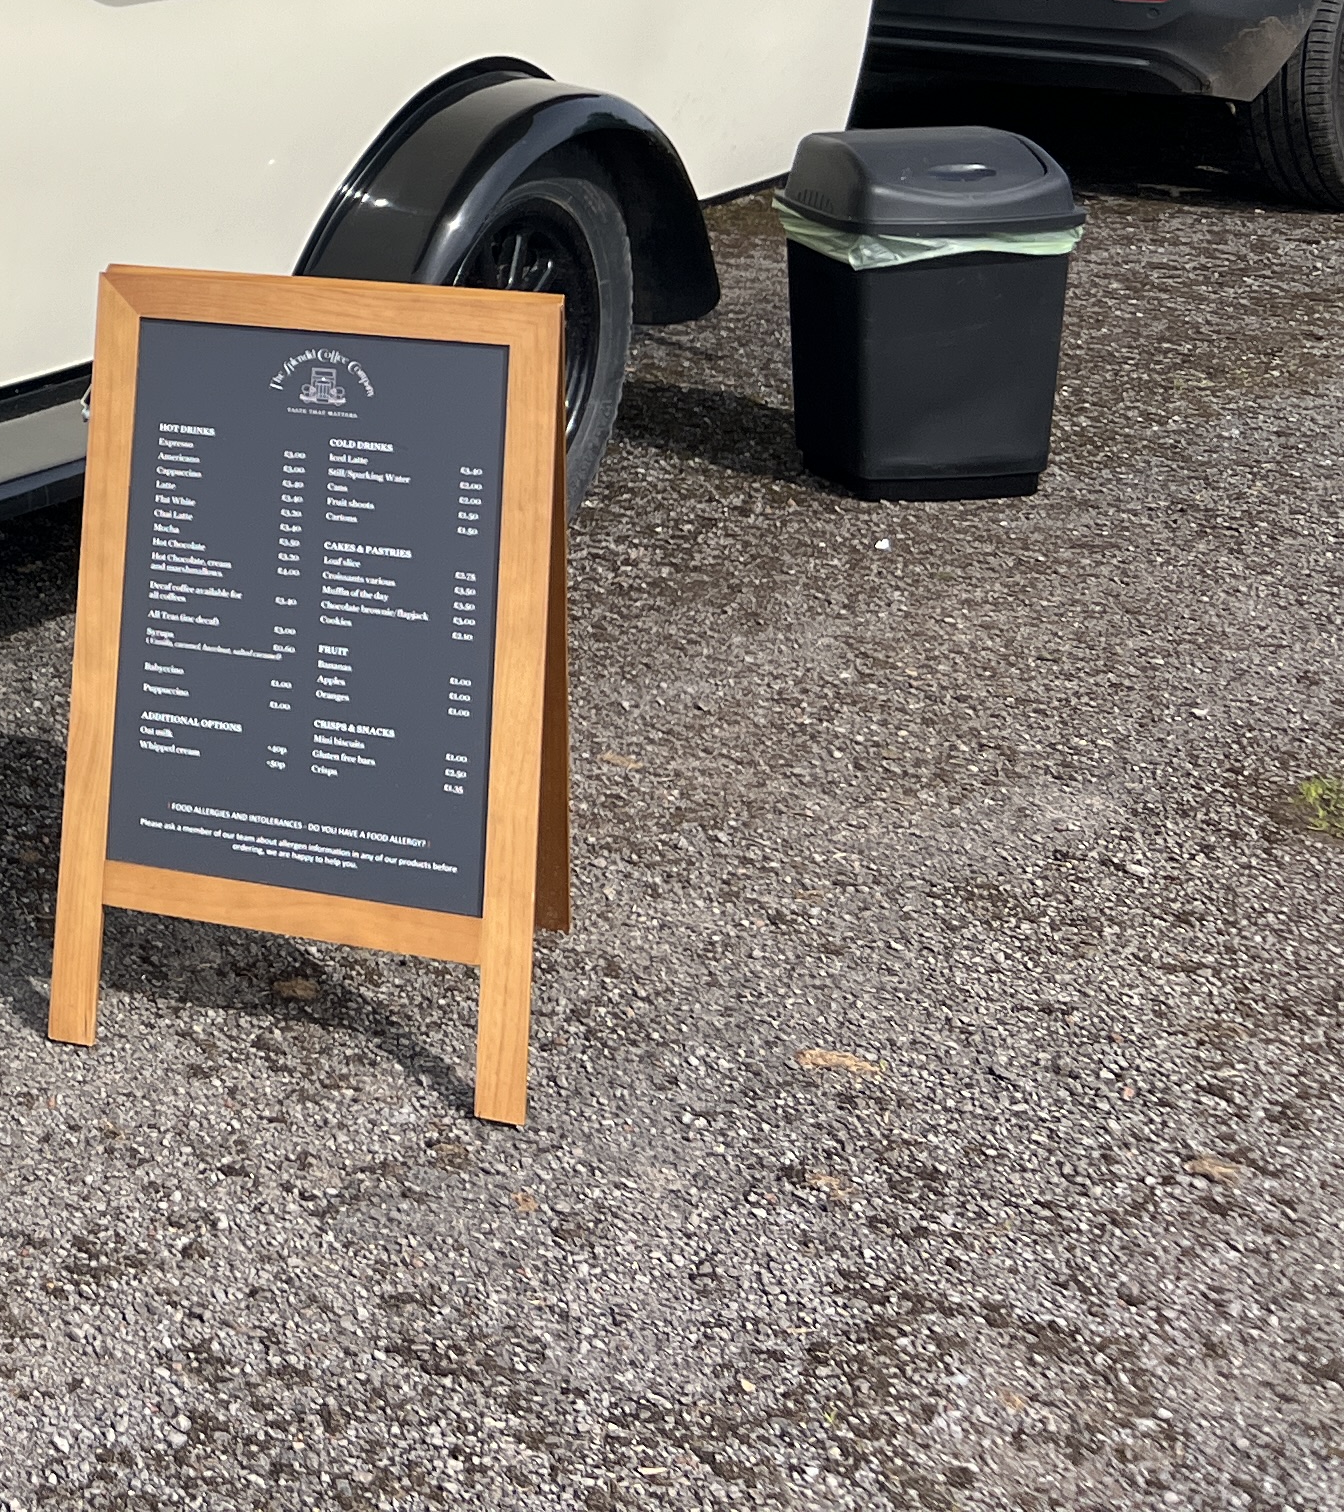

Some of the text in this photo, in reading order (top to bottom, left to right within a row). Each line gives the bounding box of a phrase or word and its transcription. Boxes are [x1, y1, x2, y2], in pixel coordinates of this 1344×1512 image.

[160, 423, 216, 436] HOT DRINKS
[159, 437, 194, 448] Expresso
[330, 439, 394, 452] COLD DRINKS
[158, 452, 200, 463] Americano
[329, 453, 347, 463] Iced
[348, 455, 369, 465] Latte
[156, 466, 202, 478] Cappuccino
[385, 473, 411, 484] Water
[156, 480, 176, 490] Latte
[155, 495, 196, 507] Flat White
[327, 497, 348, 507] Fruit
[348, 499, 375, 510] shoots
[173, 511, 194, 521] Latte
[326, 512, 358, 523] Cartons
[154, 523, 180, 534] Mocha
[153, 537, 206, 552] Hot Chocolate
[324, 541, 412, 559] CAKES & PASTRIES
[152, 552, 166, 561] Hot
[167, 554, 207, 566] Chocolate,
[324, 556, 361, 568] Loaf slice
[322, 571, 365, 583] Croissants
[230, 590, 243, 599] for
[322, 586, 350, 597] Muffin
[350, 589, 360, 598] of
[360, 590, 373, 599] the
[373, 591, 389, 603] day
[321, 601, 360, 613] Chocolate
[148, 610, 161, 619] All
[320, 615, 353, 627] Cookies
[319, 645, 349, 657] FRUIT
[145, 662, 185, 675] Babyccino
[317, 675, 346, 686] Apples
[143, 683, 190, 697] Puppuccino
[316, 690, 350, 702] Oranges
[141, 711, 243, 733] ADDITIONAL OPTIONS
[314, 720, 396, 738] CRISPS & SNACKS
[140, 740, 176, 753] Whipped
[314, 734, 333, 745] Mini
[334, 737, 365, 749] biscuits
[312, 750, 340, 761] Gluten
[341, 753, 357, 763] free
[357, 755, 376, 766] bars
[311, 765, 338, 777] Crisps
[171, 803, 426, 847] FOOD ALLERGIES AND INTOLERANCES DO YOU HAVE A FOOD ALLERGY?
[140, 818, 163, 829] Please
[164, 823, 176, 831] ask
[182, 826, 213, 836] member
[213, 829, 222, 837] of
[236, 833, 255, 842] team
[256, 836, 277, 846] about
[278, 839, 307, 851] allergen
[308, 844, 351, 857] information
[352, 850, 360, 859] in
[360, 853, 374, 862] any
[375, 854, 384, 862] of
[384, 856, 398, 864] our
[398, 859, 432, 870] products
[433, 862, 458, 874] before
[232, 844, 358, 869] ordering, we are happy to help you.
